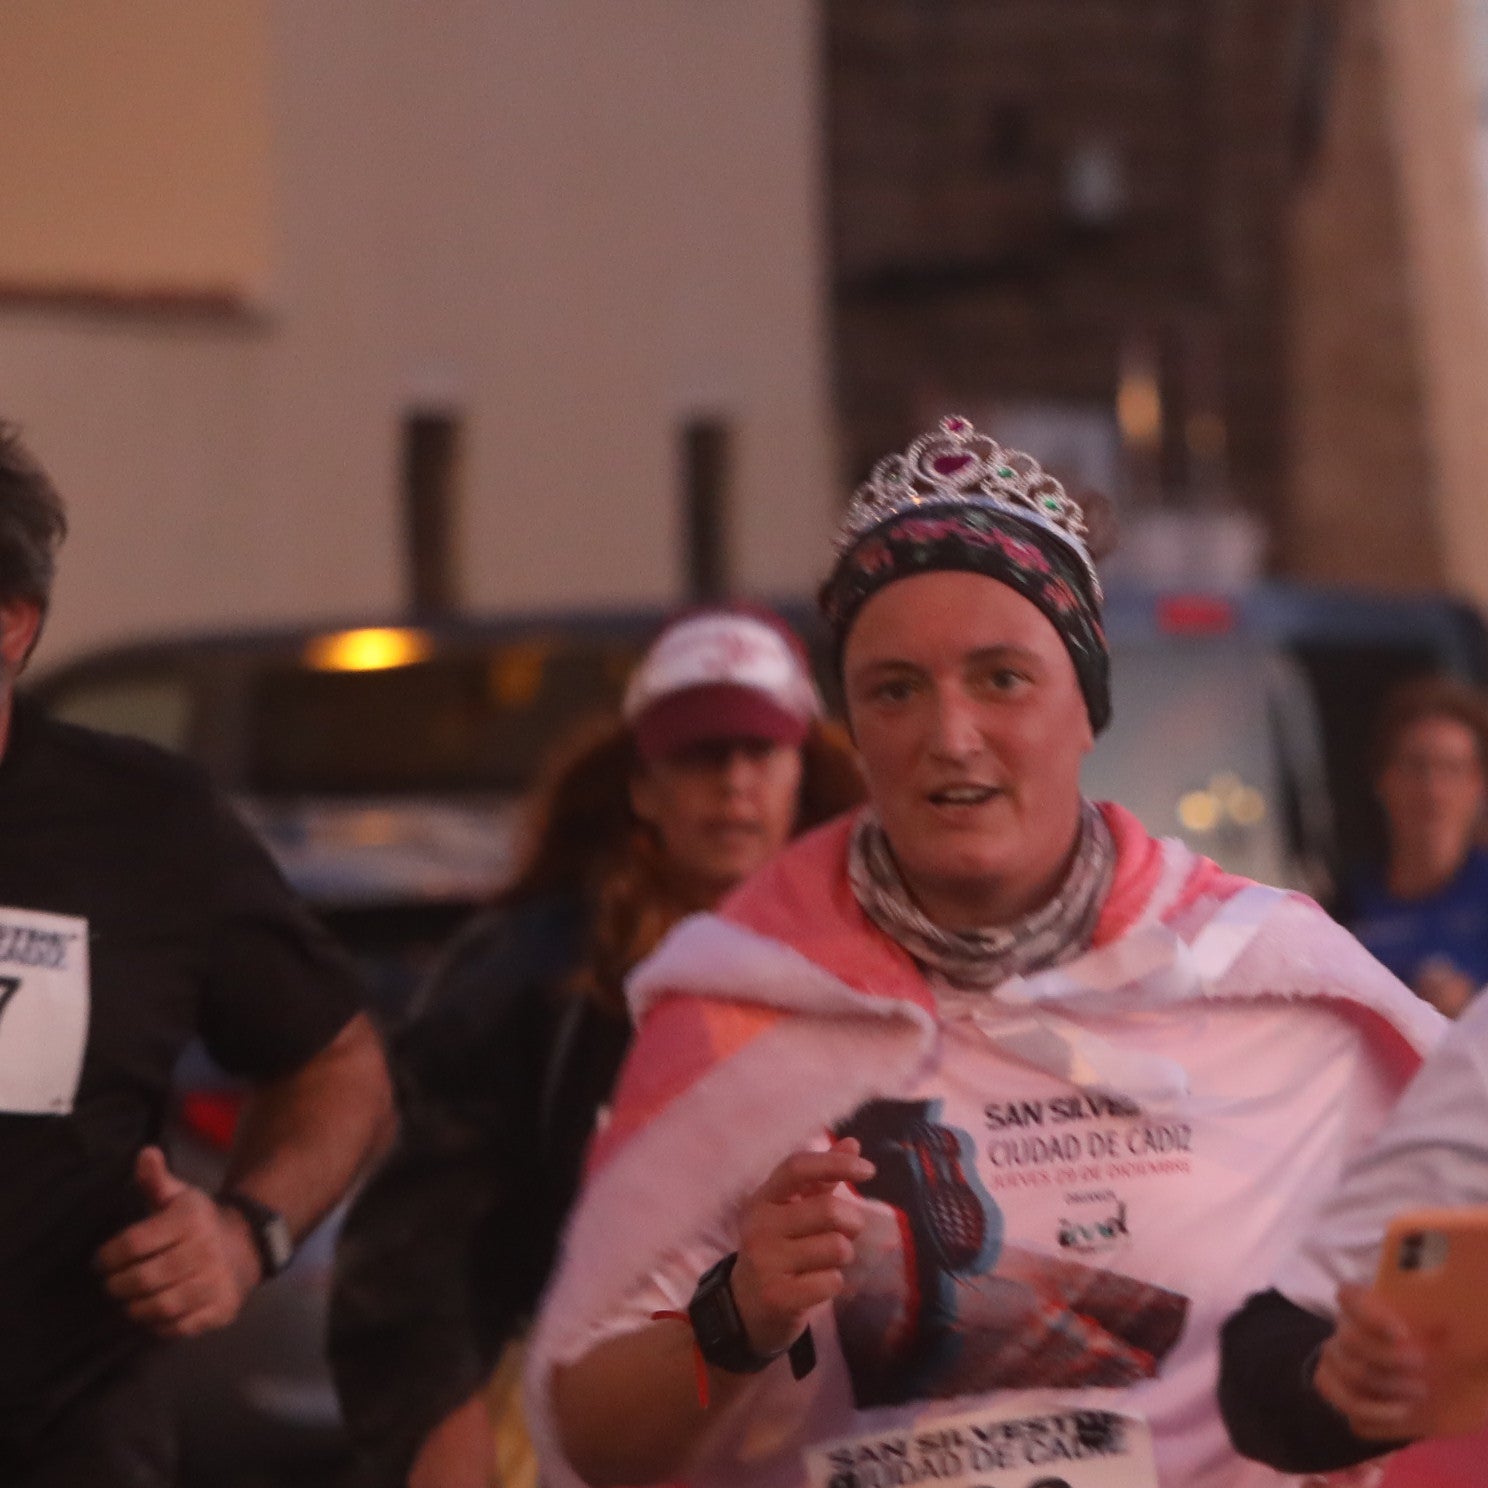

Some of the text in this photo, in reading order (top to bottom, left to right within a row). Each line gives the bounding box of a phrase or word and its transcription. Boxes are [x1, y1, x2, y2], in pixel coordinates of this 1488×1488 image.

[984, 1101, 1043, 1130] SAN
[987, 1133, 1081, 1167] CIUDAD
[1086, 1129, 1119, 1159] DE
[829, 1438, 906, 1469] SAN
[968, 1442, 1014, 1472] DE
